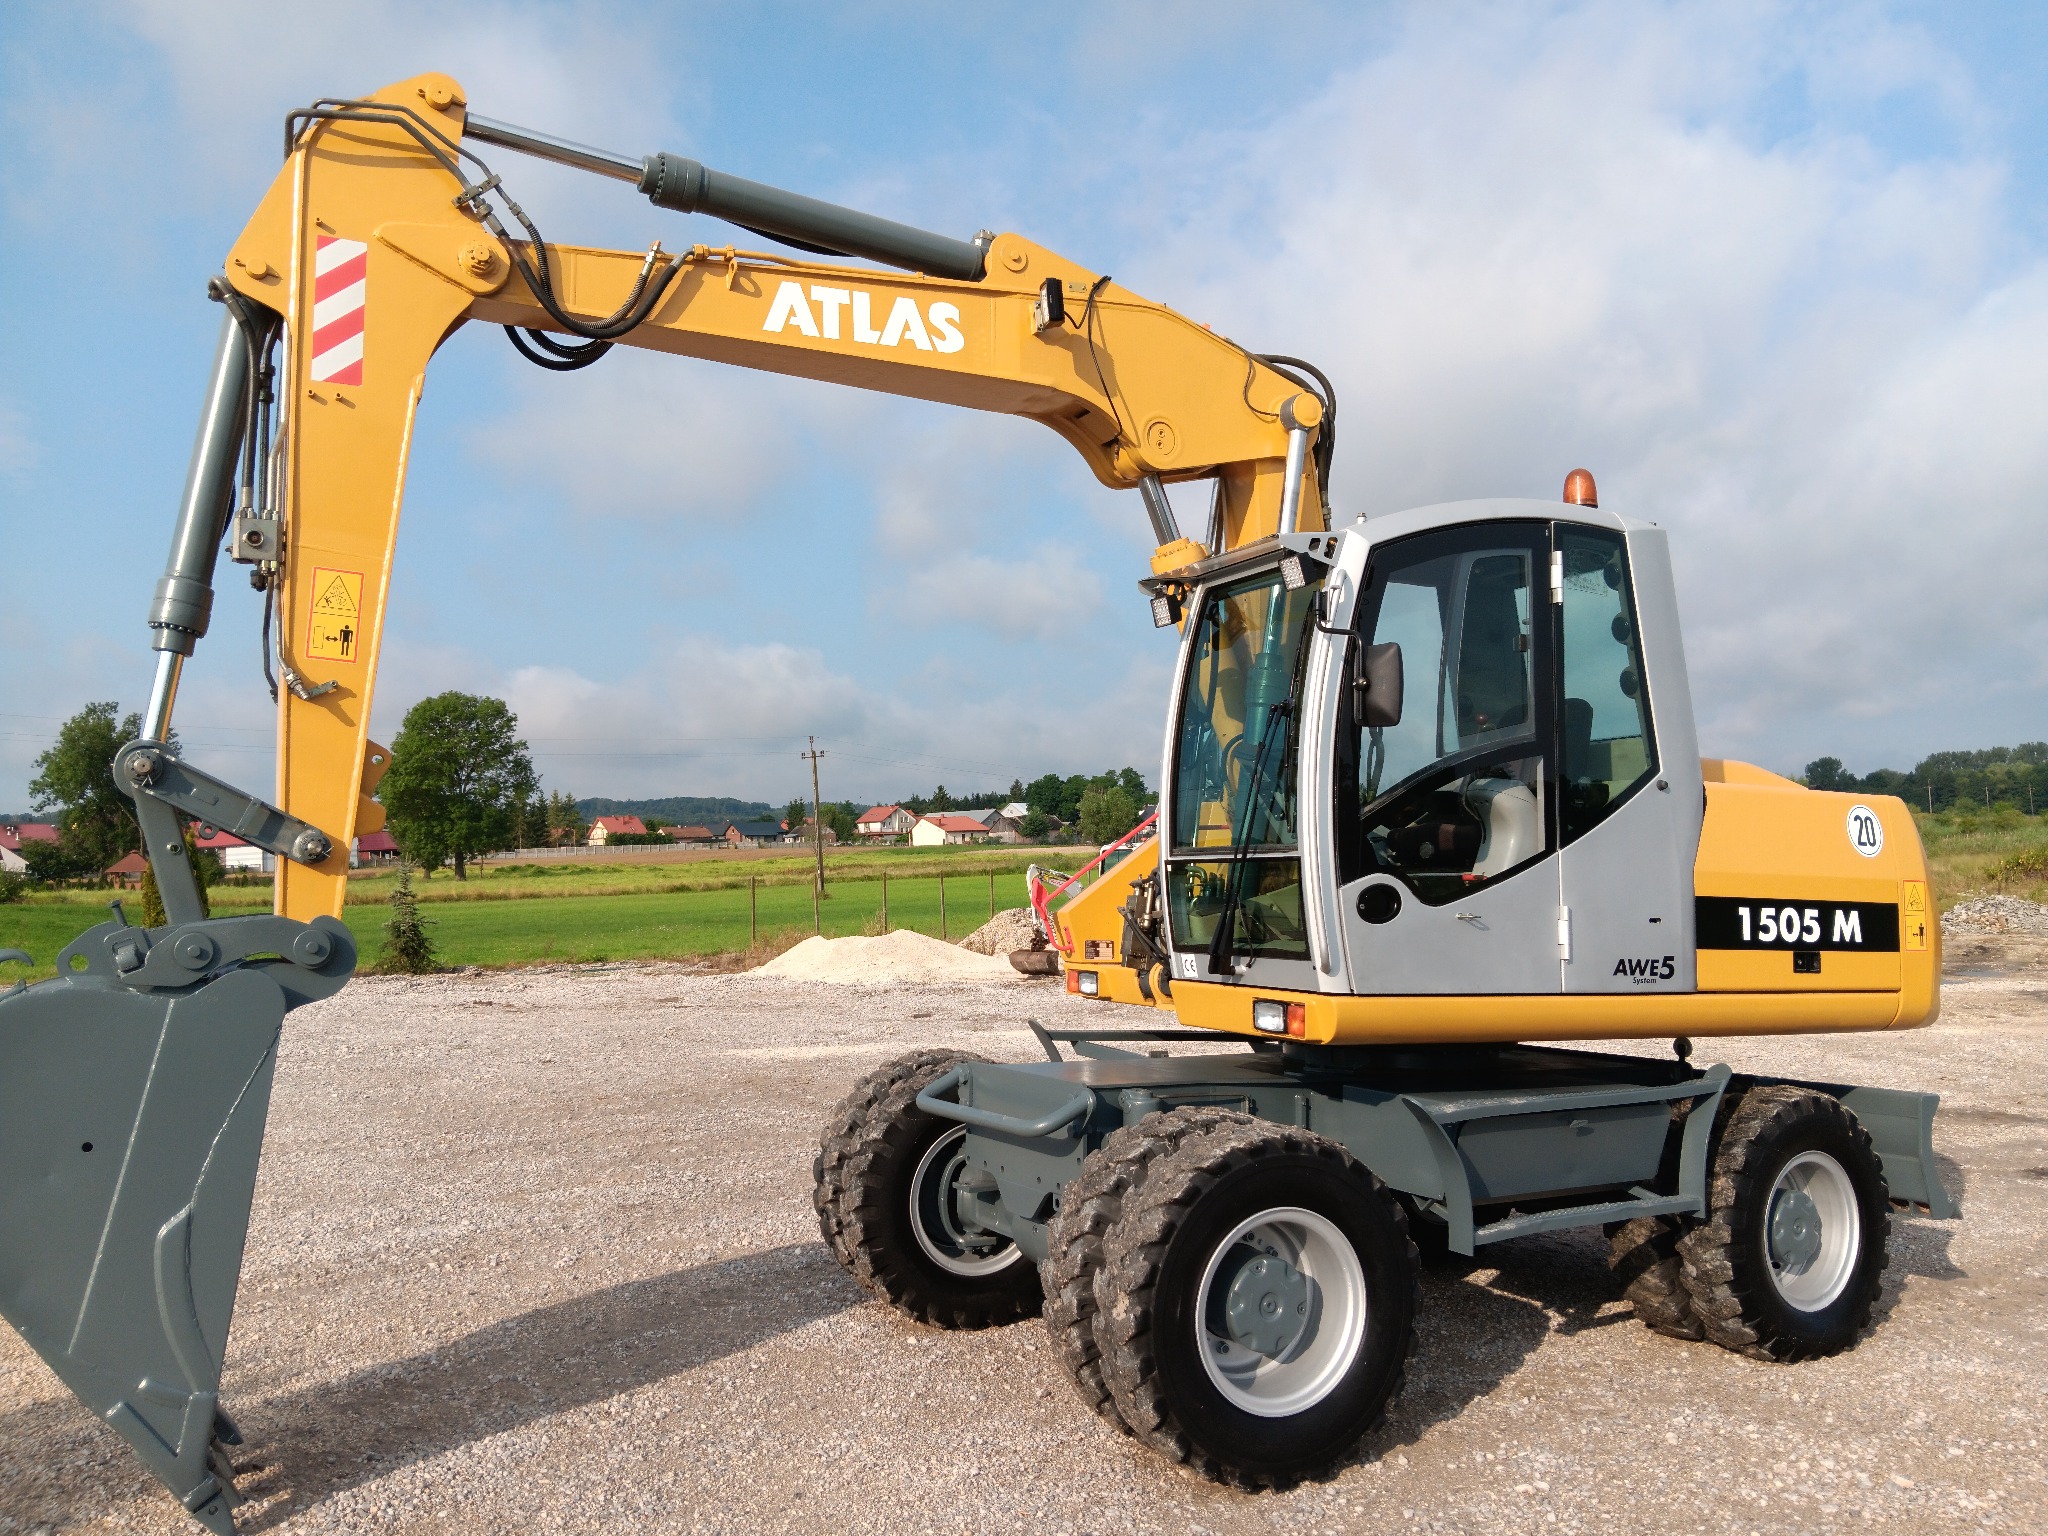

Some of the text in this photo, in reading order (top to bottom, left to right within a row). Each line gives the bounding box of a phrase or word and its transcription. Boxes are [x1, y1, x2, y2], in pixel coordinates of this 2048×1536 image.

[762, 281, 965, 354] ATLAS
[1854, 815, 1877, 847] 20
[1738, 907, 1863, 943] 1505 M
[1632, 976, 1657, 986] System
